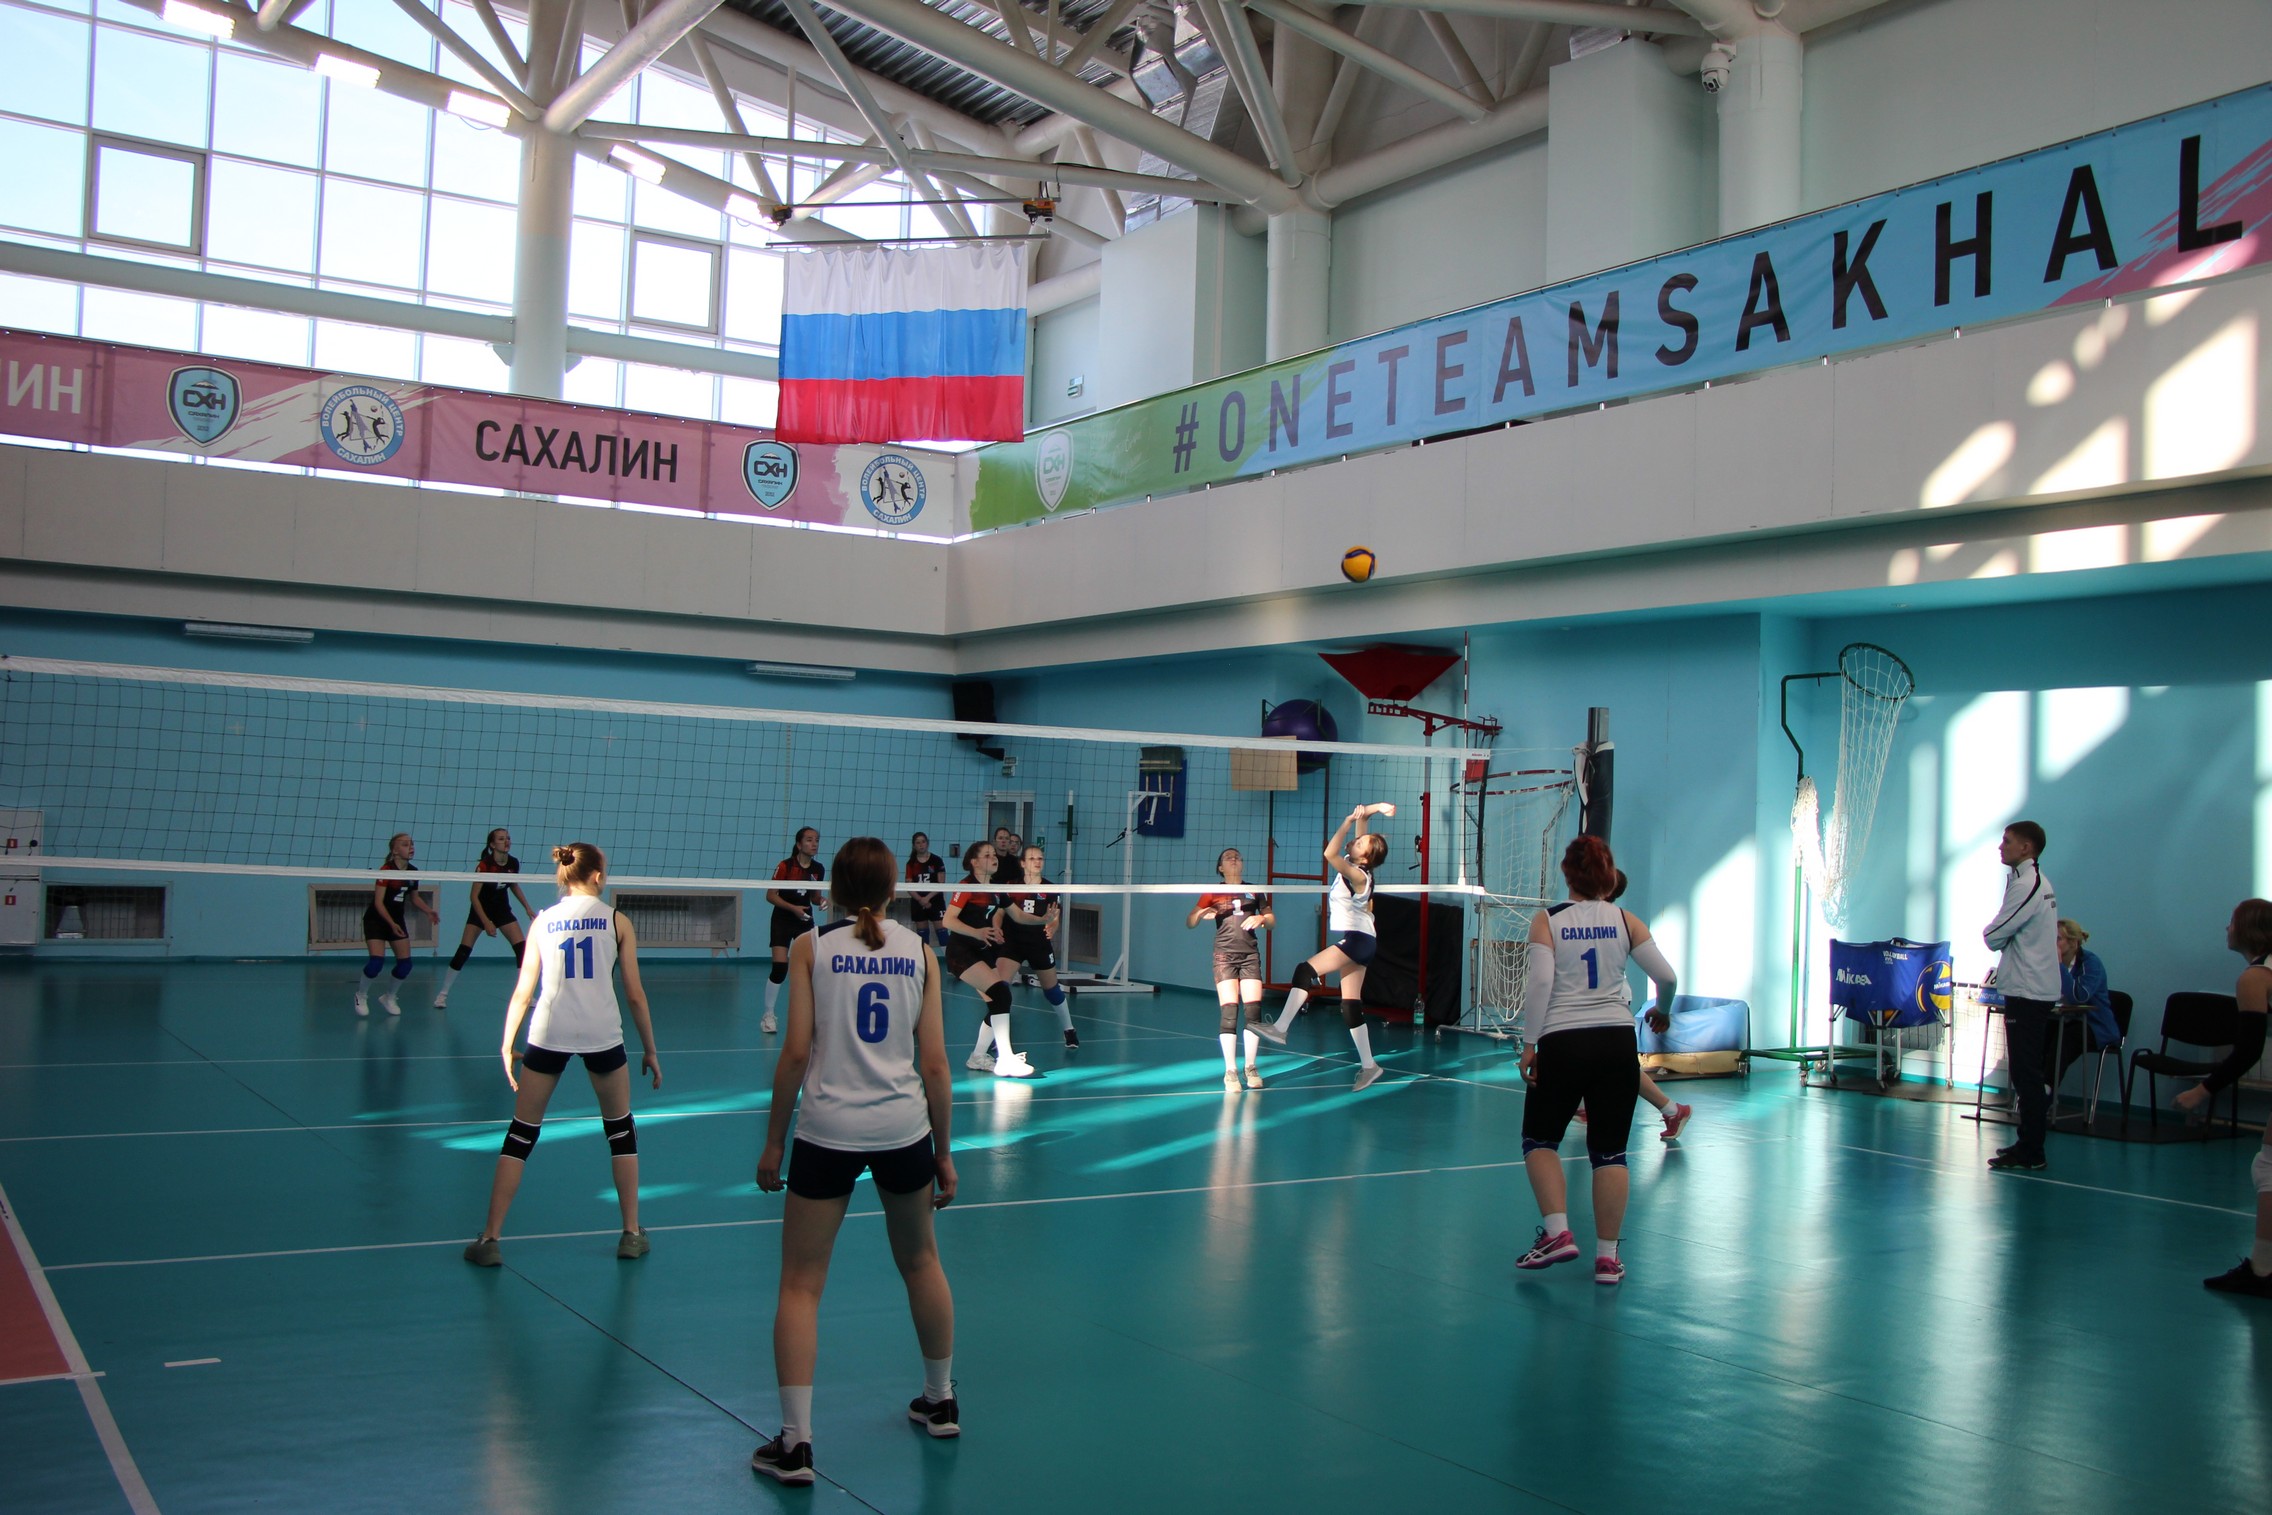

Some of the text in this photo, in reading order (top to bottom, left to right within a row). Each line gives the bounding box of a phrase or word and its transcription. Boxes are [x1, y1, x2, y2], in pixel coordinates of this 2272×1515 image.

[1173, 135, 2242, 474] #ONETEAMSAKHAL
[0, 358, 82, 414] ИН
[322, 387, 404, 437] ВОЛЕЙБОЛЬНЫЙ ЦЕНТР
[337, 447, 386, 465] САХАЛИН
[475, 420, 678, 483] САХАЛИН
[861, 456, 925, 499] ВОЛЕЙБОЛЬНЫЙ ЦЕНТР
[873, 510, 912, 524] САХАЛИН
[917, 873, 931, 883] 12
[393, 886, 409, 903] 2
[985, 904, 996, 920] 7
[1023, 899, 1036, 914] 8
[1231, 899, 1244, 916] 1
[547, 917, 607, 934] САХАЛИН
[1561, 926, 1617, 941] САХАЛИН
[558, 936, 594, 979] 11
[831, 954, 916, 978] САХАЛИН
[1581, 947, 1598, 990] 1
[856, 981, 890, 1044] 6
